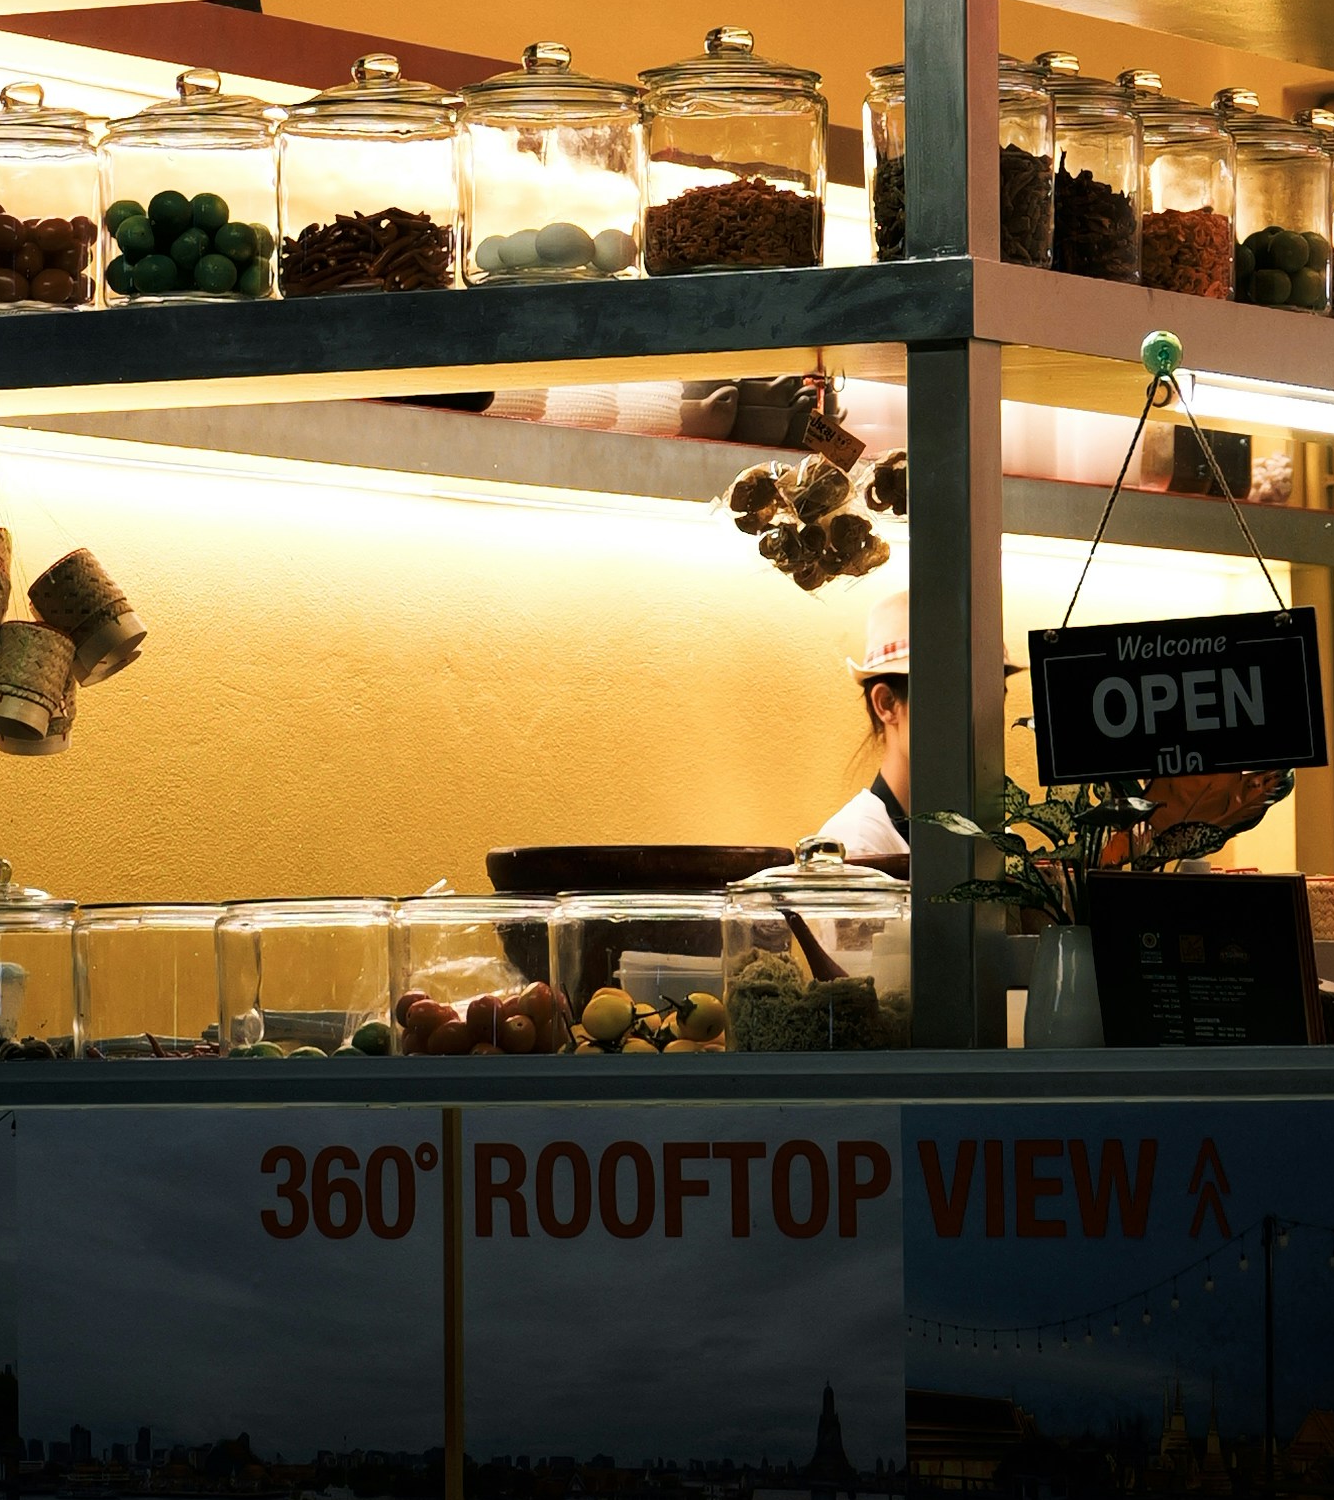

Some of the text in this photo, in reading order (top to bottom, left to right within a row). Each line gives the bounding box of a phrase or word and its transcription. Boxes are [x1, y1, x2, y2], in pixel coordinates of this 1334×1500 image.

[1115, 634, 1228, 663] Welcome
[1091, 664, 1267, 738] OPEN
[1156, 744, 1205, 777] เปิด
[260, 1137, 1159, 1241] 360° ROOFTOP VIEW
